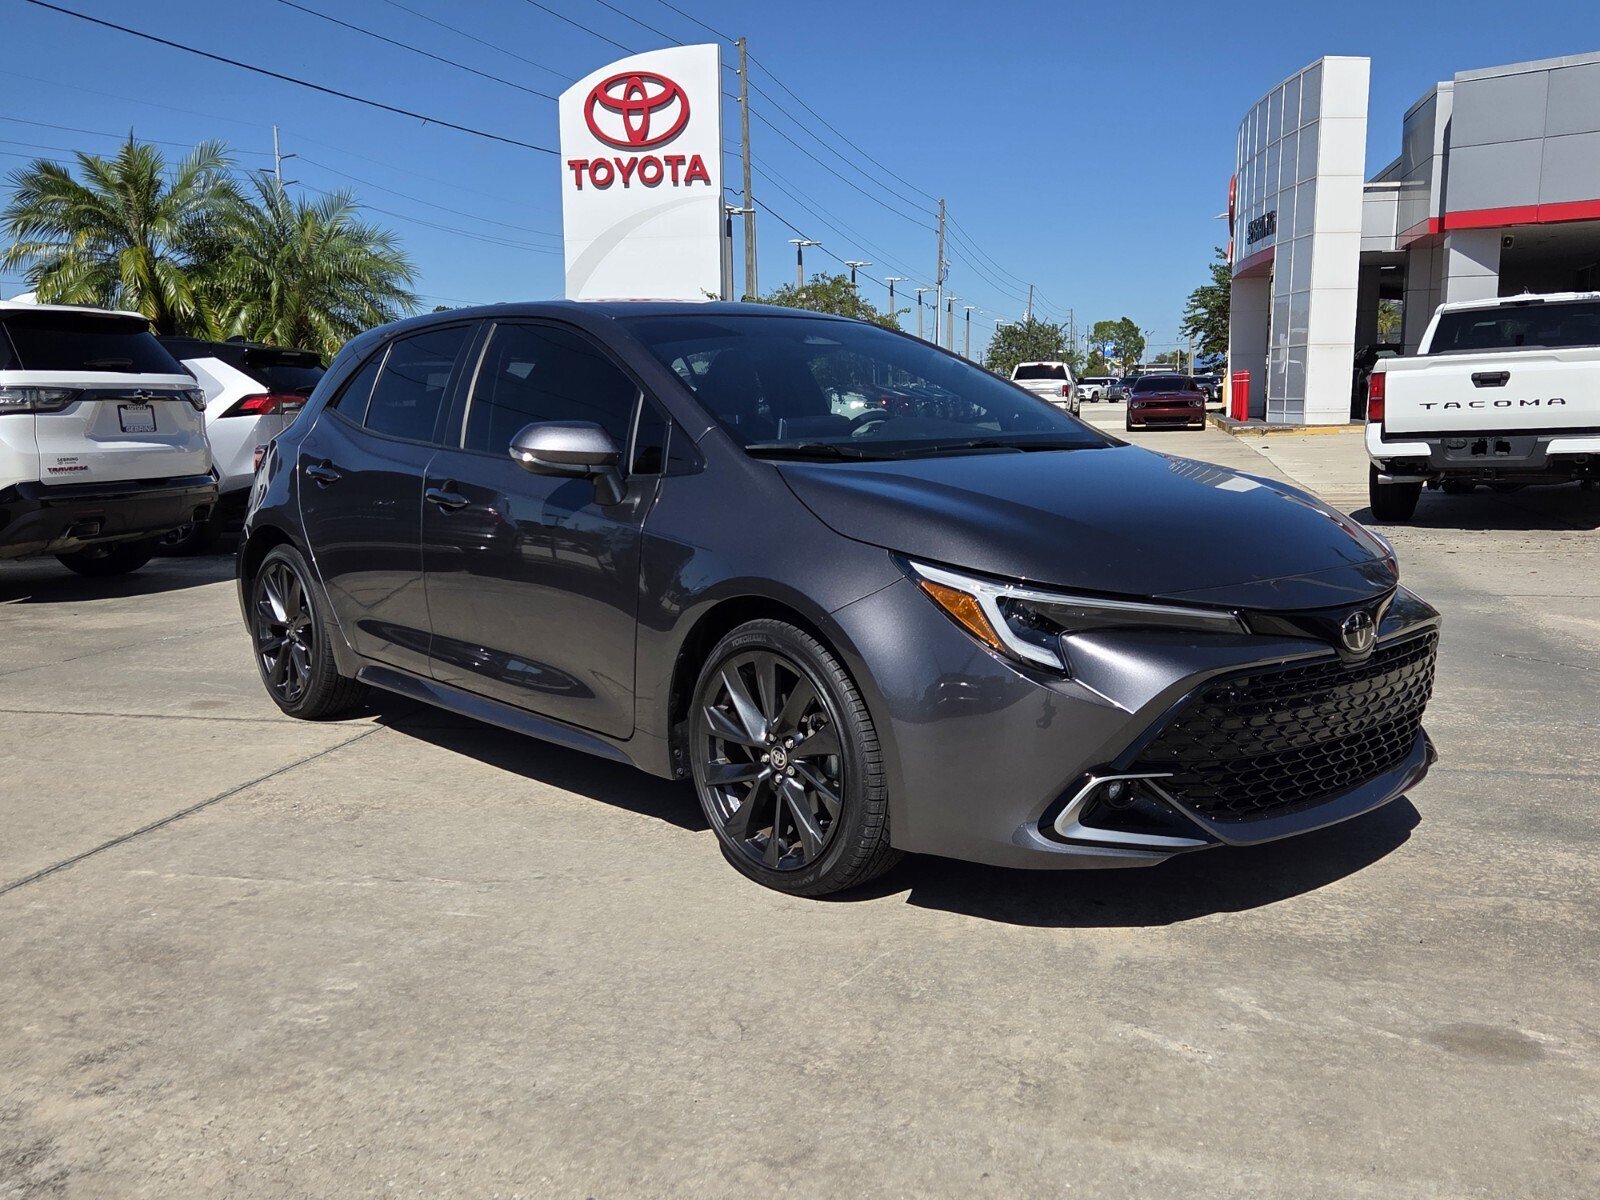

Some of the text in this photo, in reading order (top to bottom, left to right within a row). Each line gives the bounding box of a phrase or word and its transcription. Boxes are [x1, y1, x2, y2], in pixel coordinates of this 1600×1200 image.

[568, 155, 711, 190] TOYOTA
[1419, 398, 1566, 410] TACOMA
[47, 465, 88, 473] TRAVERSE
[732, 634, 767, 647] YOKOHAMA
